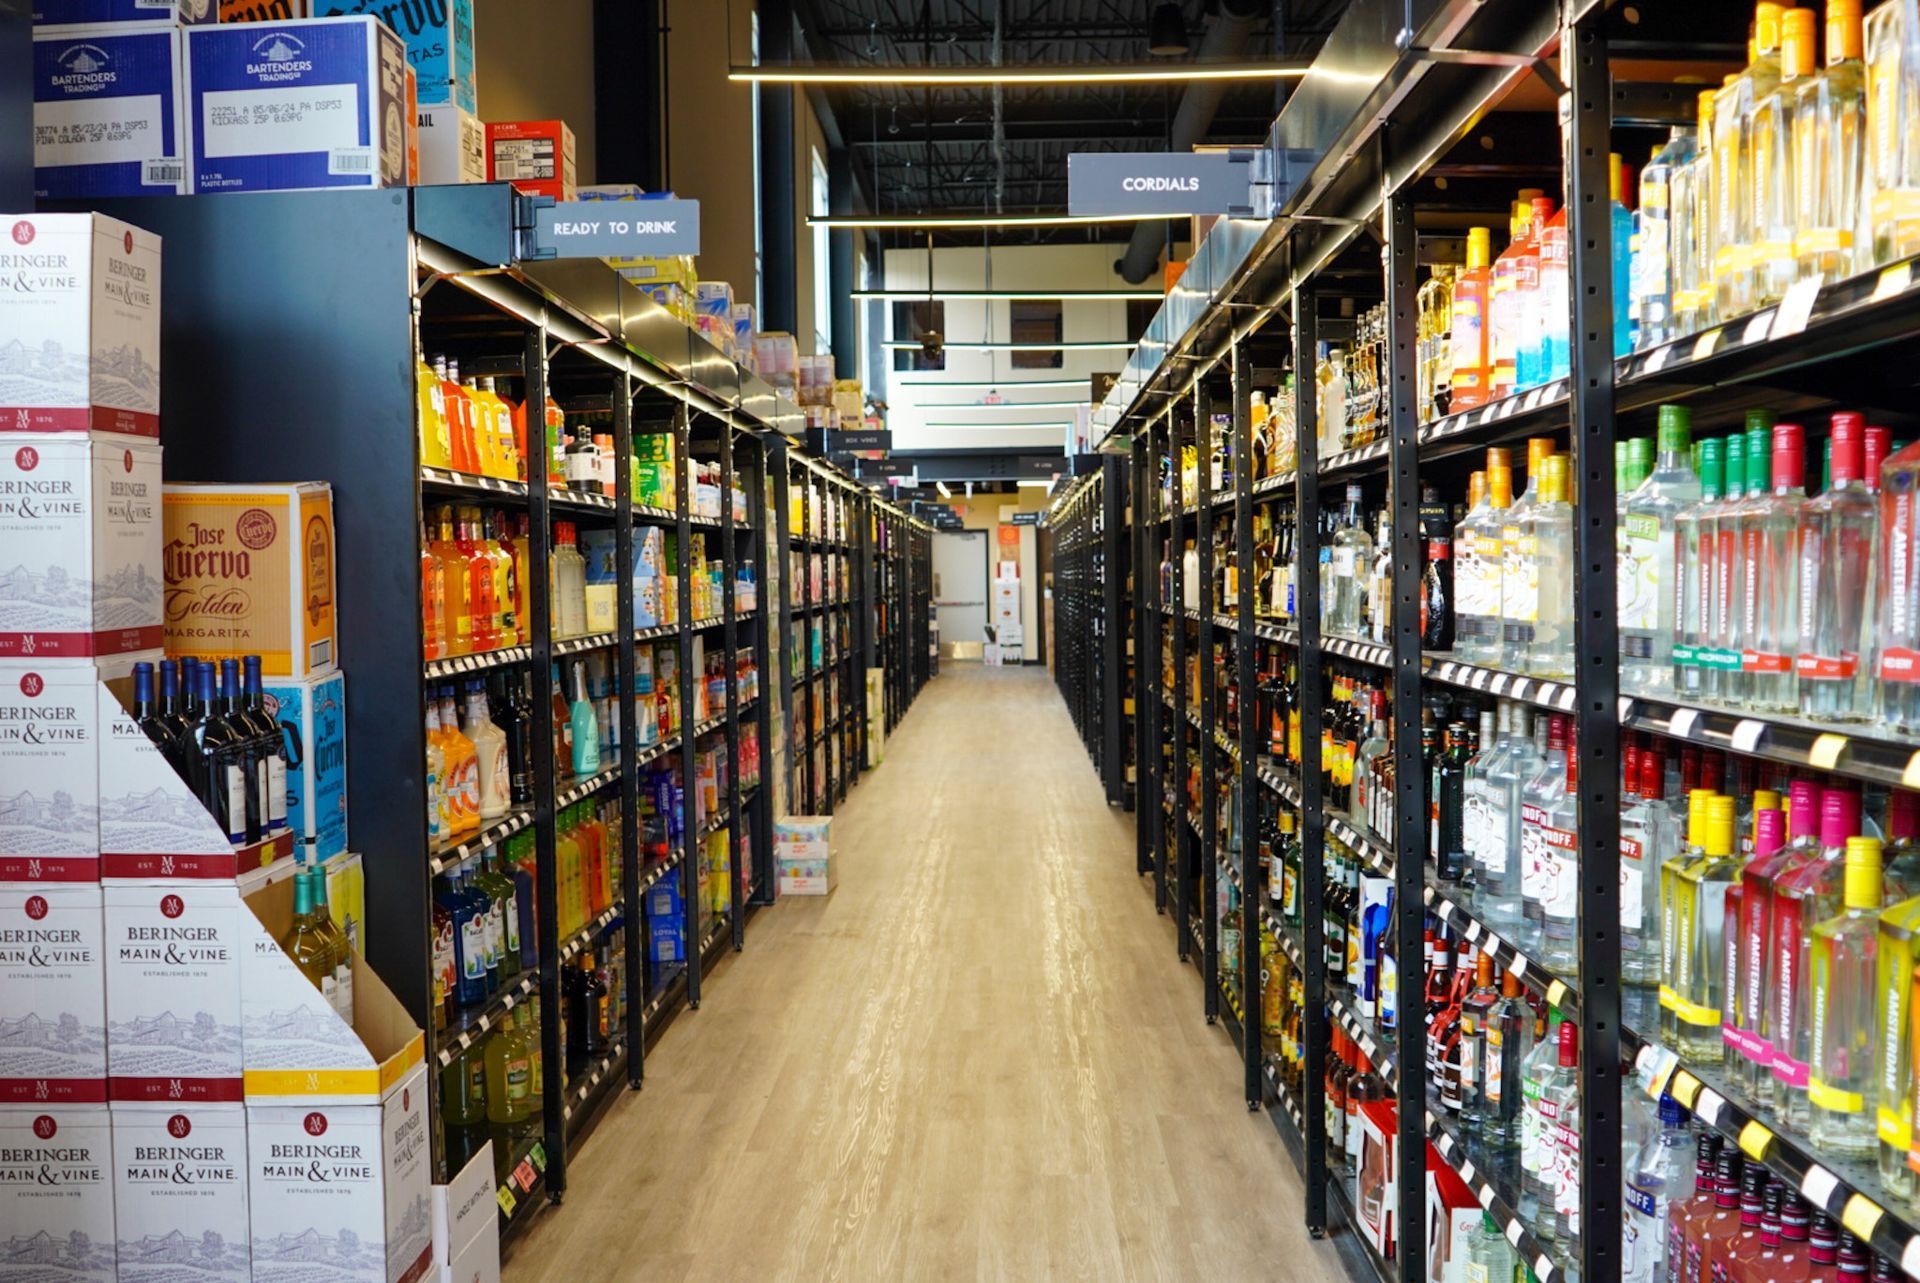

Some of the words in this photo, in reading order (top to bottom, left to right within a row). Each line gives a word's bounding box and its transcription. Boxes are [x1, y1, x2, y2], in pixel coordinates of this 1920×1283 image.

[246, 60, 312, 74] BARTENDERS
[258, 73, 294, 82] TRADING
[51, 71, 116, 86] BARTENDERS
[64, 85, 99, 94] TRADING
[300, 102, 311, 112] PA
[58, 134, 86, 144] COLADA
[1122, 177, 1200, 192] CORDIALS
[554, 222, 600, 236] READY
[609, 222, 629, 235] TO
[636, 220, 677, 235] DRINK
[108, 257, 147, 282] BERINGER
[104, 281, 123, 297] MAIN
[110, 481, 148, 497] BERINGER
[18, 496, 41, 518] &
[108, 506, 126, 517] MAIN
[187, 522, 226, 549] Jose
[163, 538, 251, 586] Cuervo
[1892, 529, 1907, 634] AMSTERDAM
[163, 584, 252, 622] Golden
[1719, 562, 1728, 634] AMSTERDAM
[1745, 559, 1755, 634] AMSTERDAM
[1802, 558, 1812, 637] AMSTERDAM
[165, 628, 250, 638] MARGARITA
[0, 728, 19, 739] IN
[23, 722, 46, 744] &
[180, 862, 198, 870] 1876
[0, 930, 82, 943] ERINGER
[127, 926, 219, 941] BERINGER
[1664, 908, 1673, 975] AMSTERDAM
[28, 944, 52, 967] &
[120, 948, 160, 959] MAIN
[164, 942, 188, 965] &
[1680, 917, 1690, 986] AMSTERDAM
[1727, 942, 1737, 1014] AMSTERDAM
[1748, 932, 1761, 1020] AMSTERDAM
[1780, 949, 1791, 1040] AMSTERDAM
[1814, 986, 1824, 1068] AMSTERDAM
[1885, 988, 1900, 1092] AMSTERDAM
[394, 1111, 420, 1146] BERINGER
[1, 1148, 91, 1162] BERINGER
[135, 1146, 226, 1161] BERINGER
[270, 1144, 362, 1159] BERINGER
[38, 1164, 60, 1186] &
[127, 1168, 168, 1179] MAIN
[172, 1162, 195, 1184] &
[263, 1166, 304, 1176] MAIN
[307, 1160, 331, 1182] &
